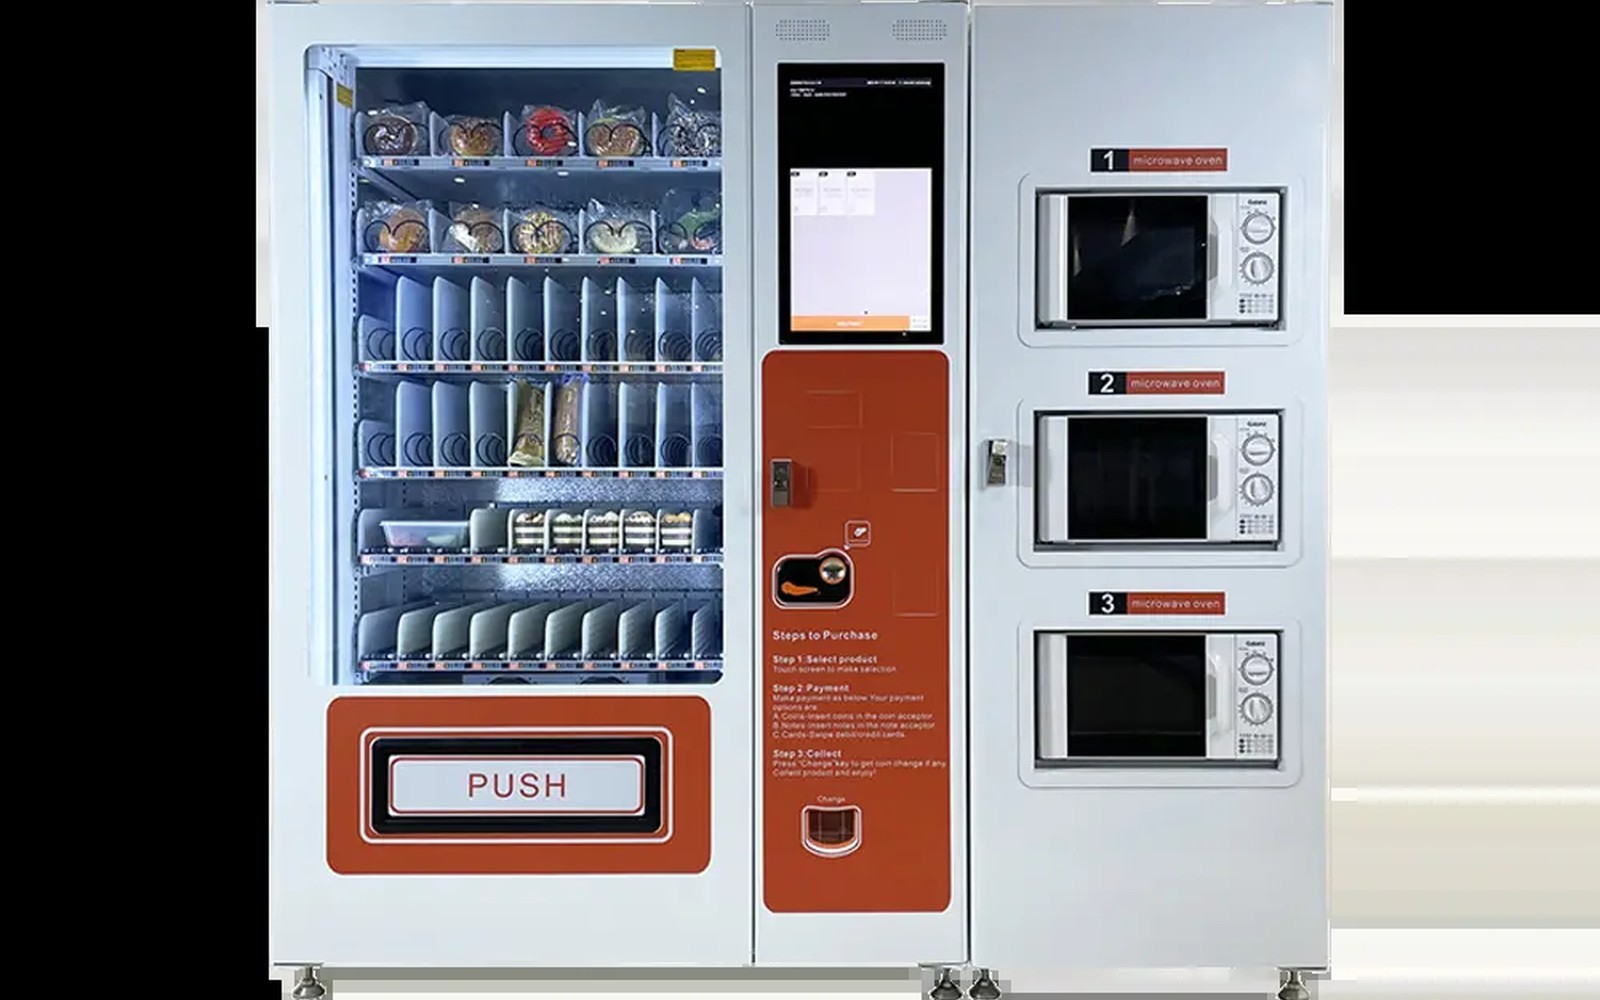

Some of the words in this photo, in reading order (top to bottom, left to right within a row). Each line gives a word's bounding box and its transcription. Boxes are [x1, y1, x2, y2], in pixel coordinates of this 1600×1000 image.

[1103, 150, 1114, 171] 1
[1133, 154, 1192, 165] microwave
[1195, 155, 1223, 165] oven
[1100, 373, 1114, 393] 2
[1131, 378, 1191, 388] microwave
[1193, 379, 1220, 388] oven
[1101, 593, 1115, 613] 3
[1131, 598, 1191, 608] microwave
[1193, 599, 1220, 609] oven
[773, 630, 806, 642] Steps
[808, 630, 821, 641] to
[823, 630, 878, 641] Purchase
[773, 655, 795, 664] Step
[838, 655, 878, 665] product
[773, 665, 797, 673] Touch
[836, 665, 859, 673] make
[773, 684, 795, 693] Step
[773, 749, 795, 758] Step
[468, 772, 567, 798] PUSH
[816, 795, 846, 803] Change
